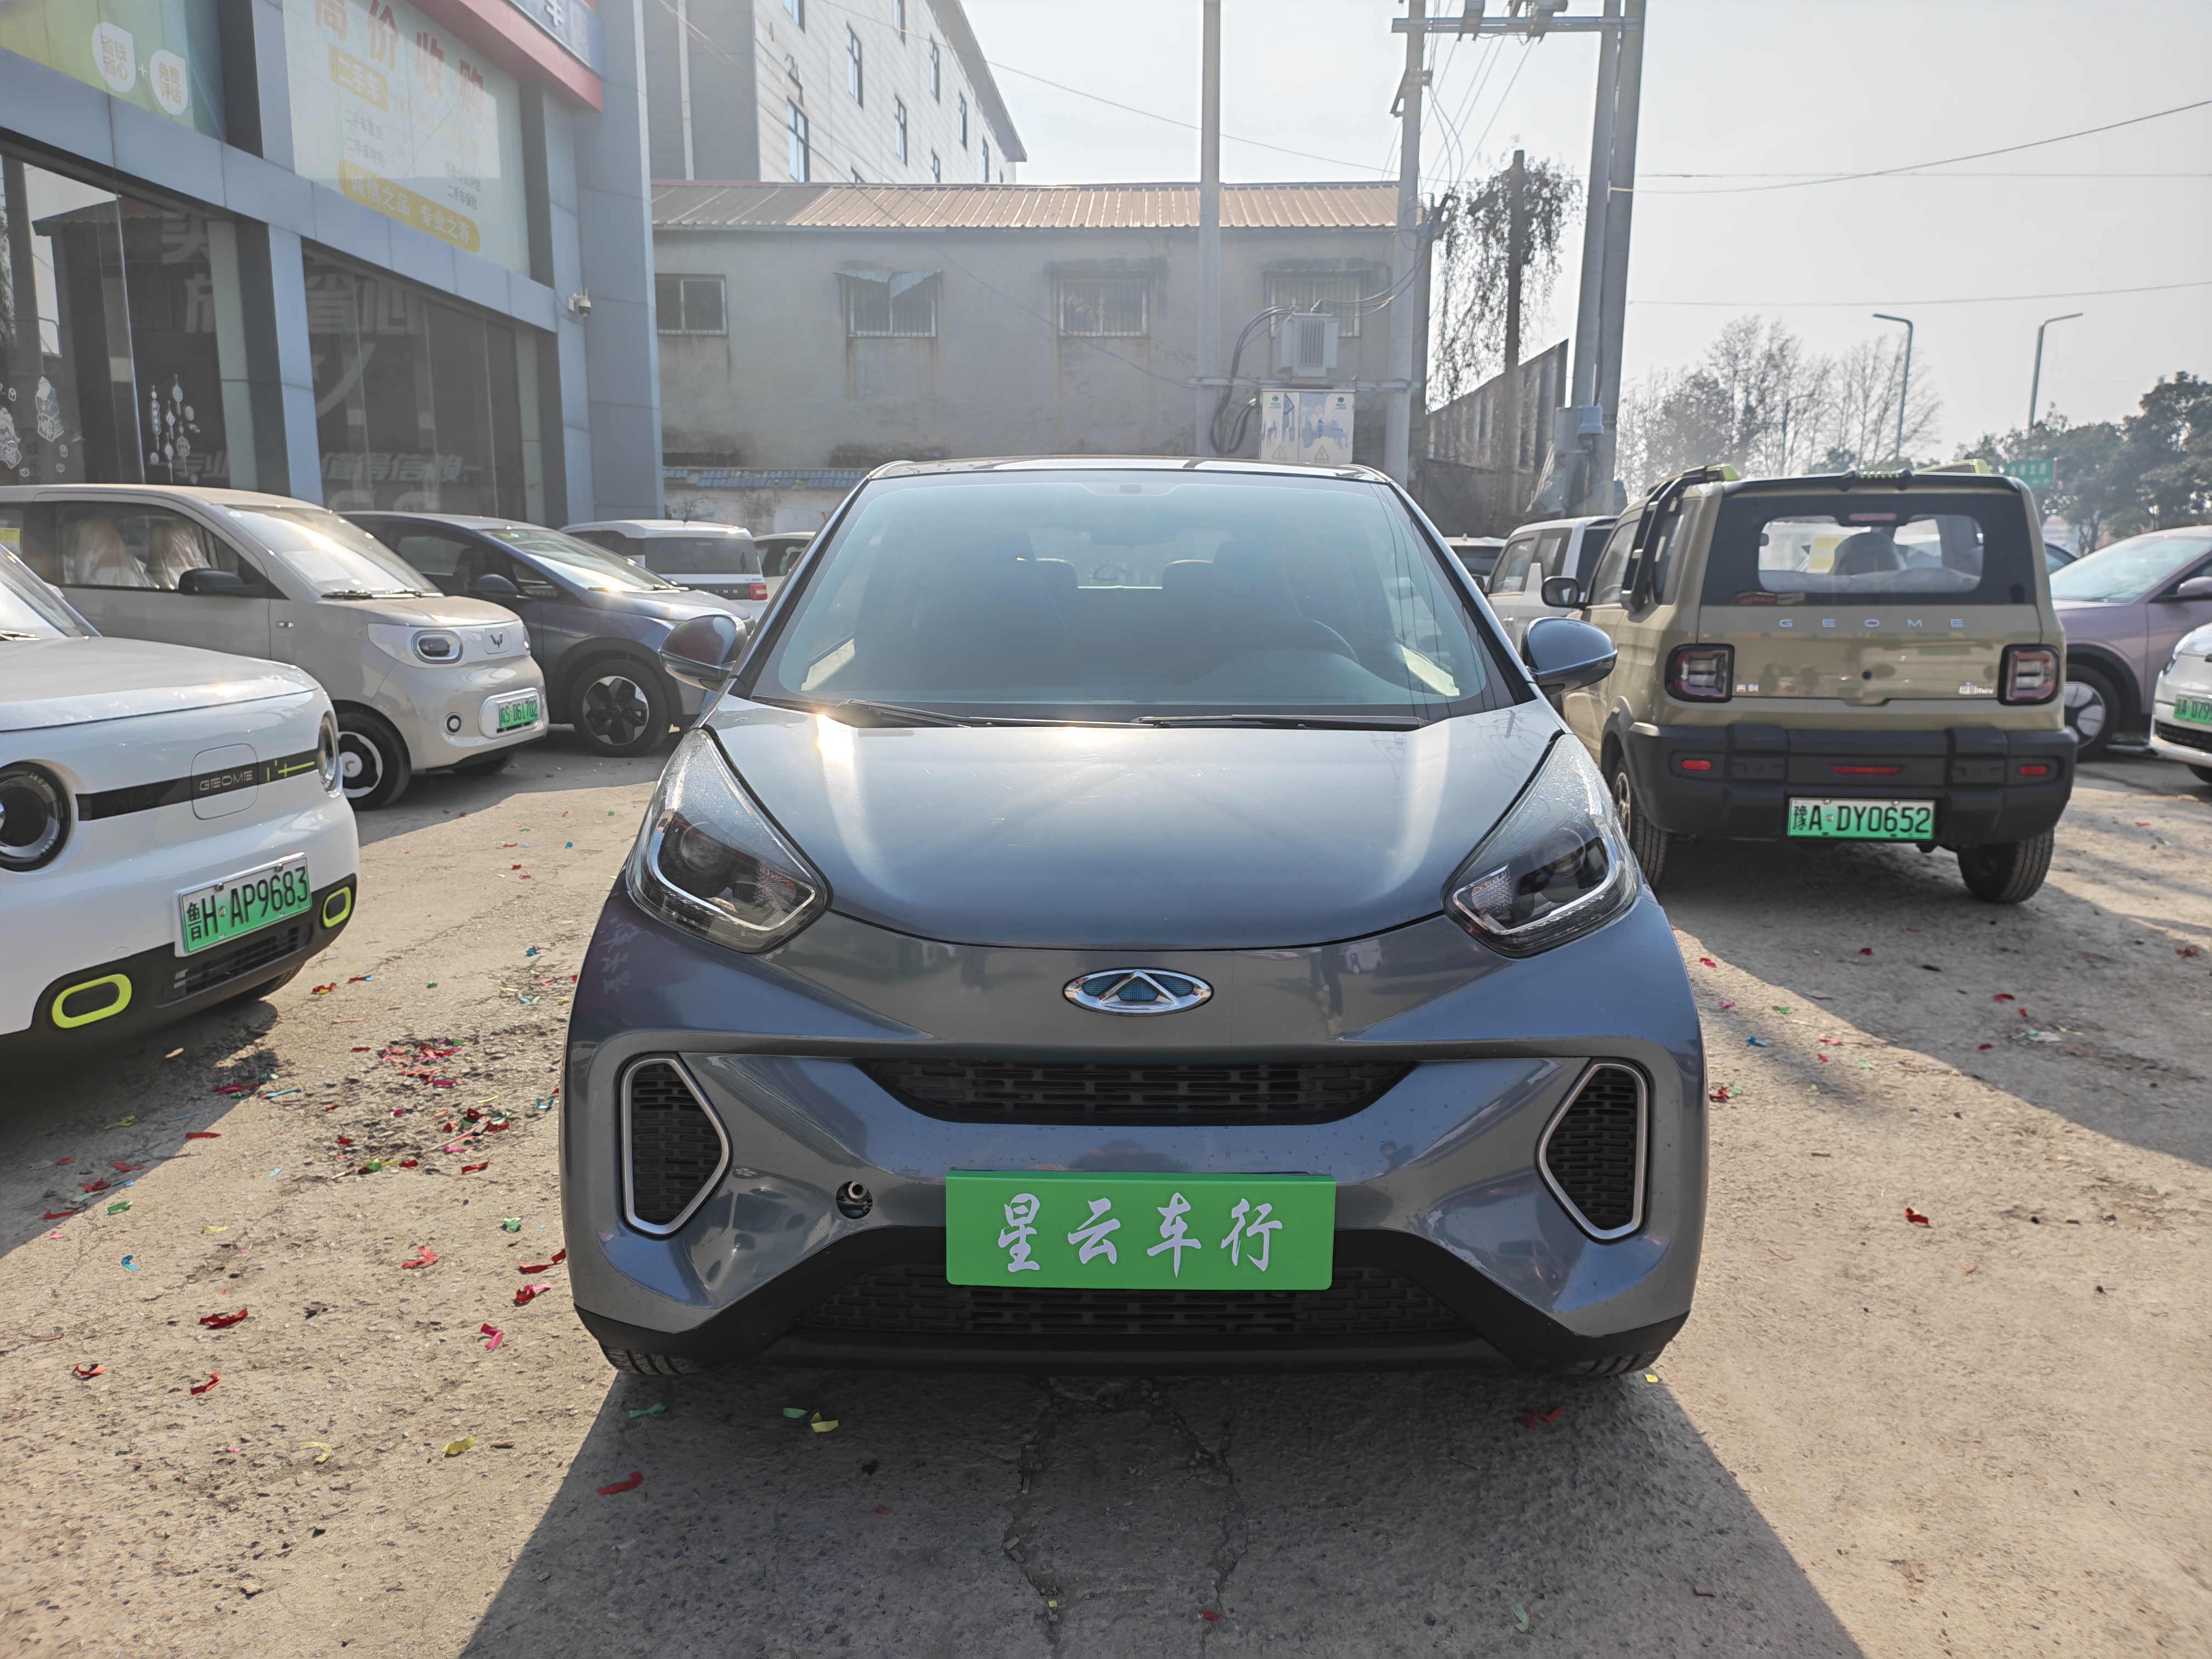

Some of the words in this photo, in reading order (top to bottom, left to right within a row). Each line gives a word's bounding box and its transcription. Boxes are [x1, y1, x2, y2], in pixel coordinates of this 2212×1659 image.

[101, 35, 127, 63] 省钱
[103, 55, 129, 81] 省心
[158, 61, 180, 87] 免费
[337, 57, 381, 102] 二手车
[160, 79, 182, 106] 评估
[350, 170, 410, 217] 诚信之品
[421, 204, 471, 245] 专业之荐
[1779, 618, 1964, 628] GEOME
[199, 770, 253, 792] GEOME
[997, 1192, 1284, 1278] 星云车行
